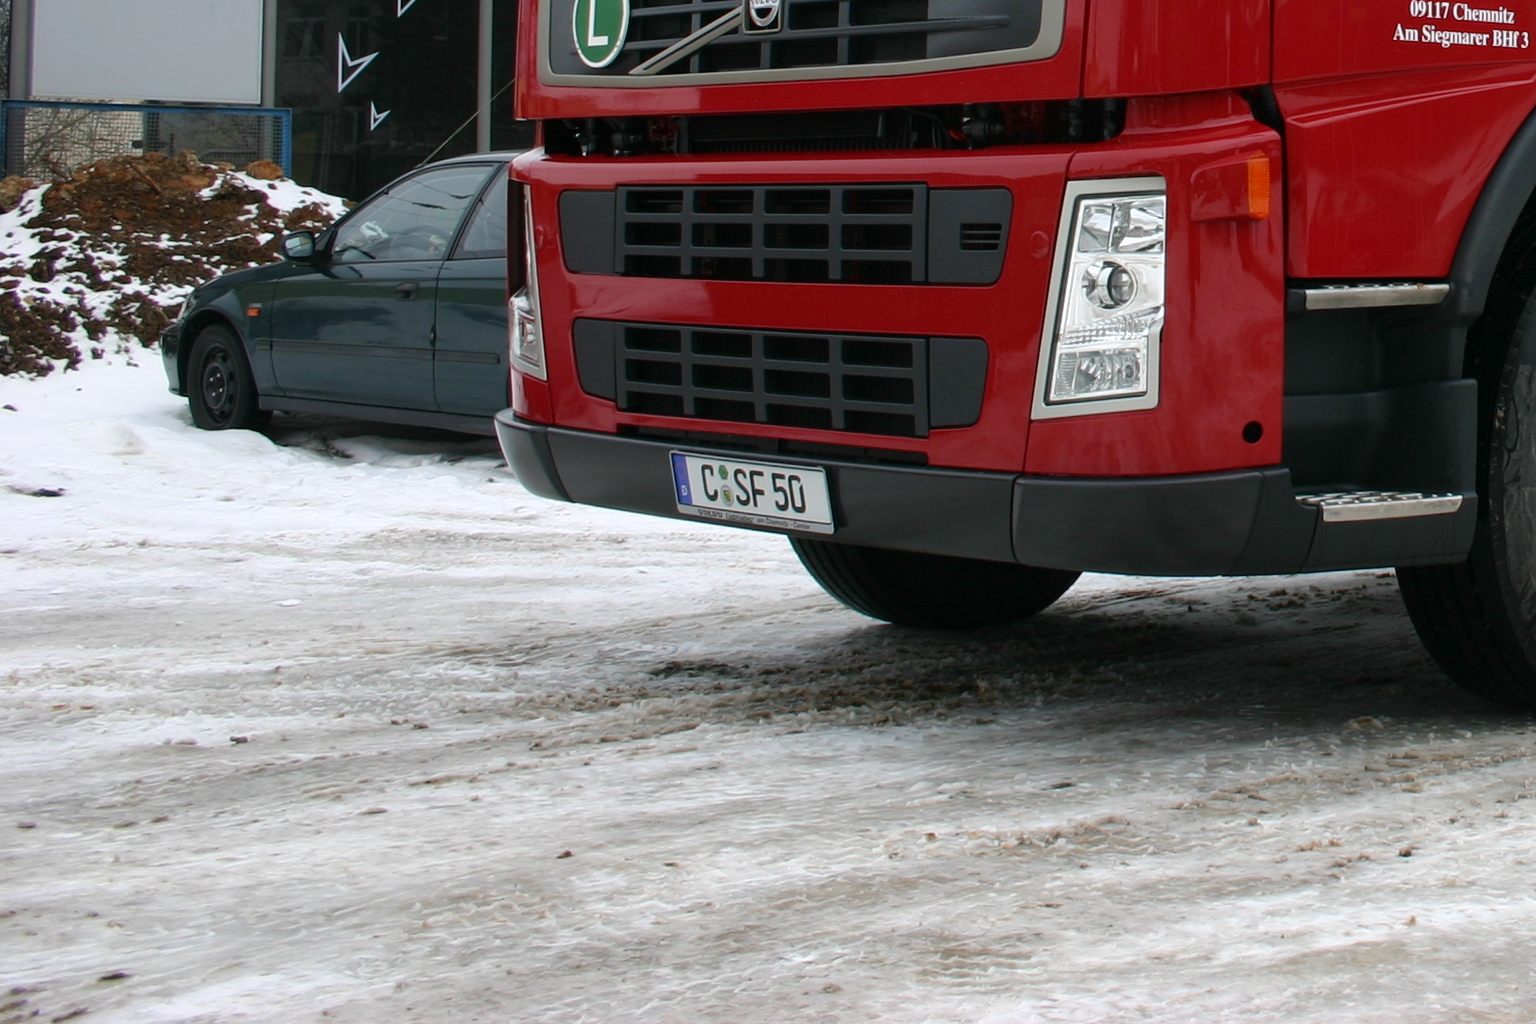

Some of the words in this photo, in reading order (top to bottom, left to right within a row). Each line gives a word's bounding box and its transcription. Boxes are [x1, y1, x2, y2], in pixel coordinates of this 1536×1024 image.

[1409, 0, 1450, 19] 09117
[1453, 3, 1515, 25] Chemnitz
[1392, 23, 1419, 42] Am
[1422, 24, 1489, 49] Siegmarer
[1492, 30, 1519, 48] BHf
[1521, 32, 1530, 49] 3
[701, 464, 718, 502] C
[733, 468, 765, 507] SF
[771, 472, 806, 514] 50
